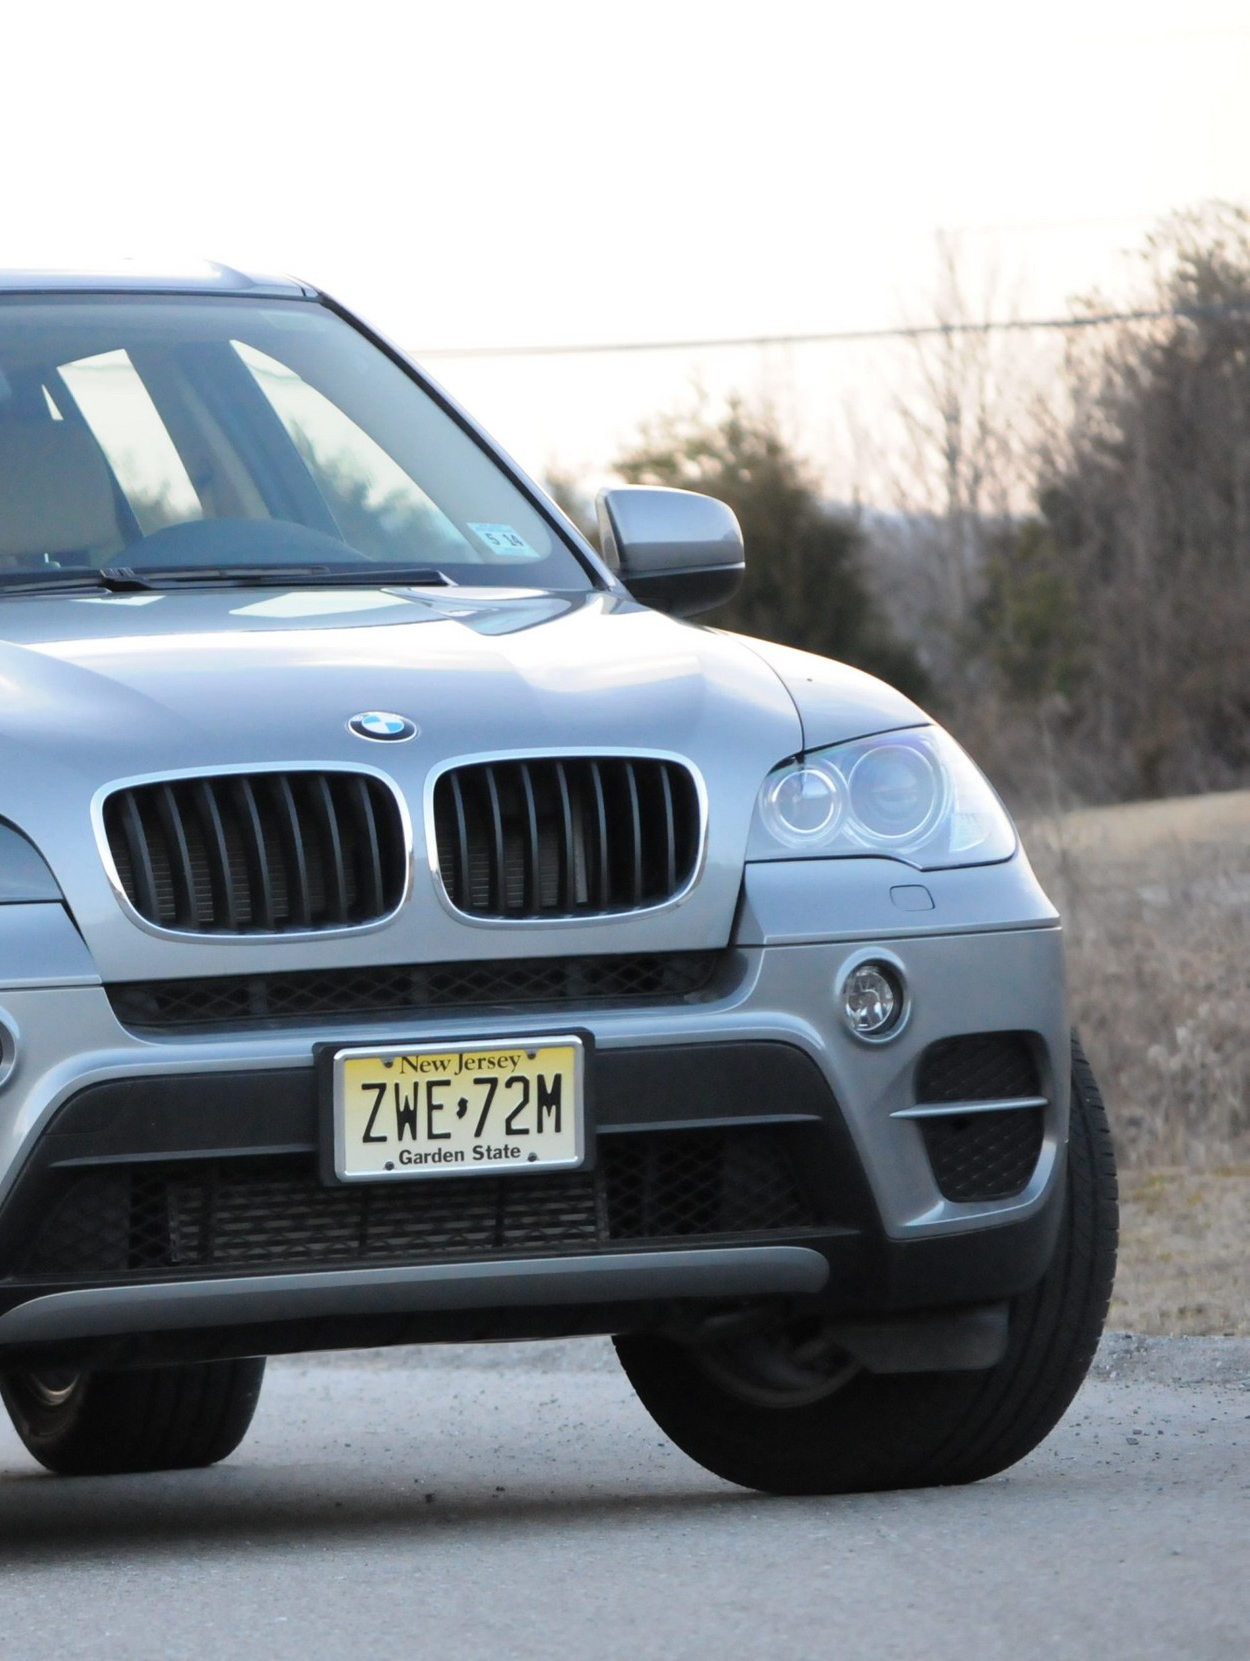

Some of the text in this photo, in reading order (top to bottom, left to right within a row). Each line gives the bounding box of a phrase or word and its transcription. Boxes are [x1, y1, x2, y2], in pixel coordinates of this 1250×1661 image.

[399, 1053, 521, 1076] New Jersey
[399, 1144, 521, 1165] Garden State
